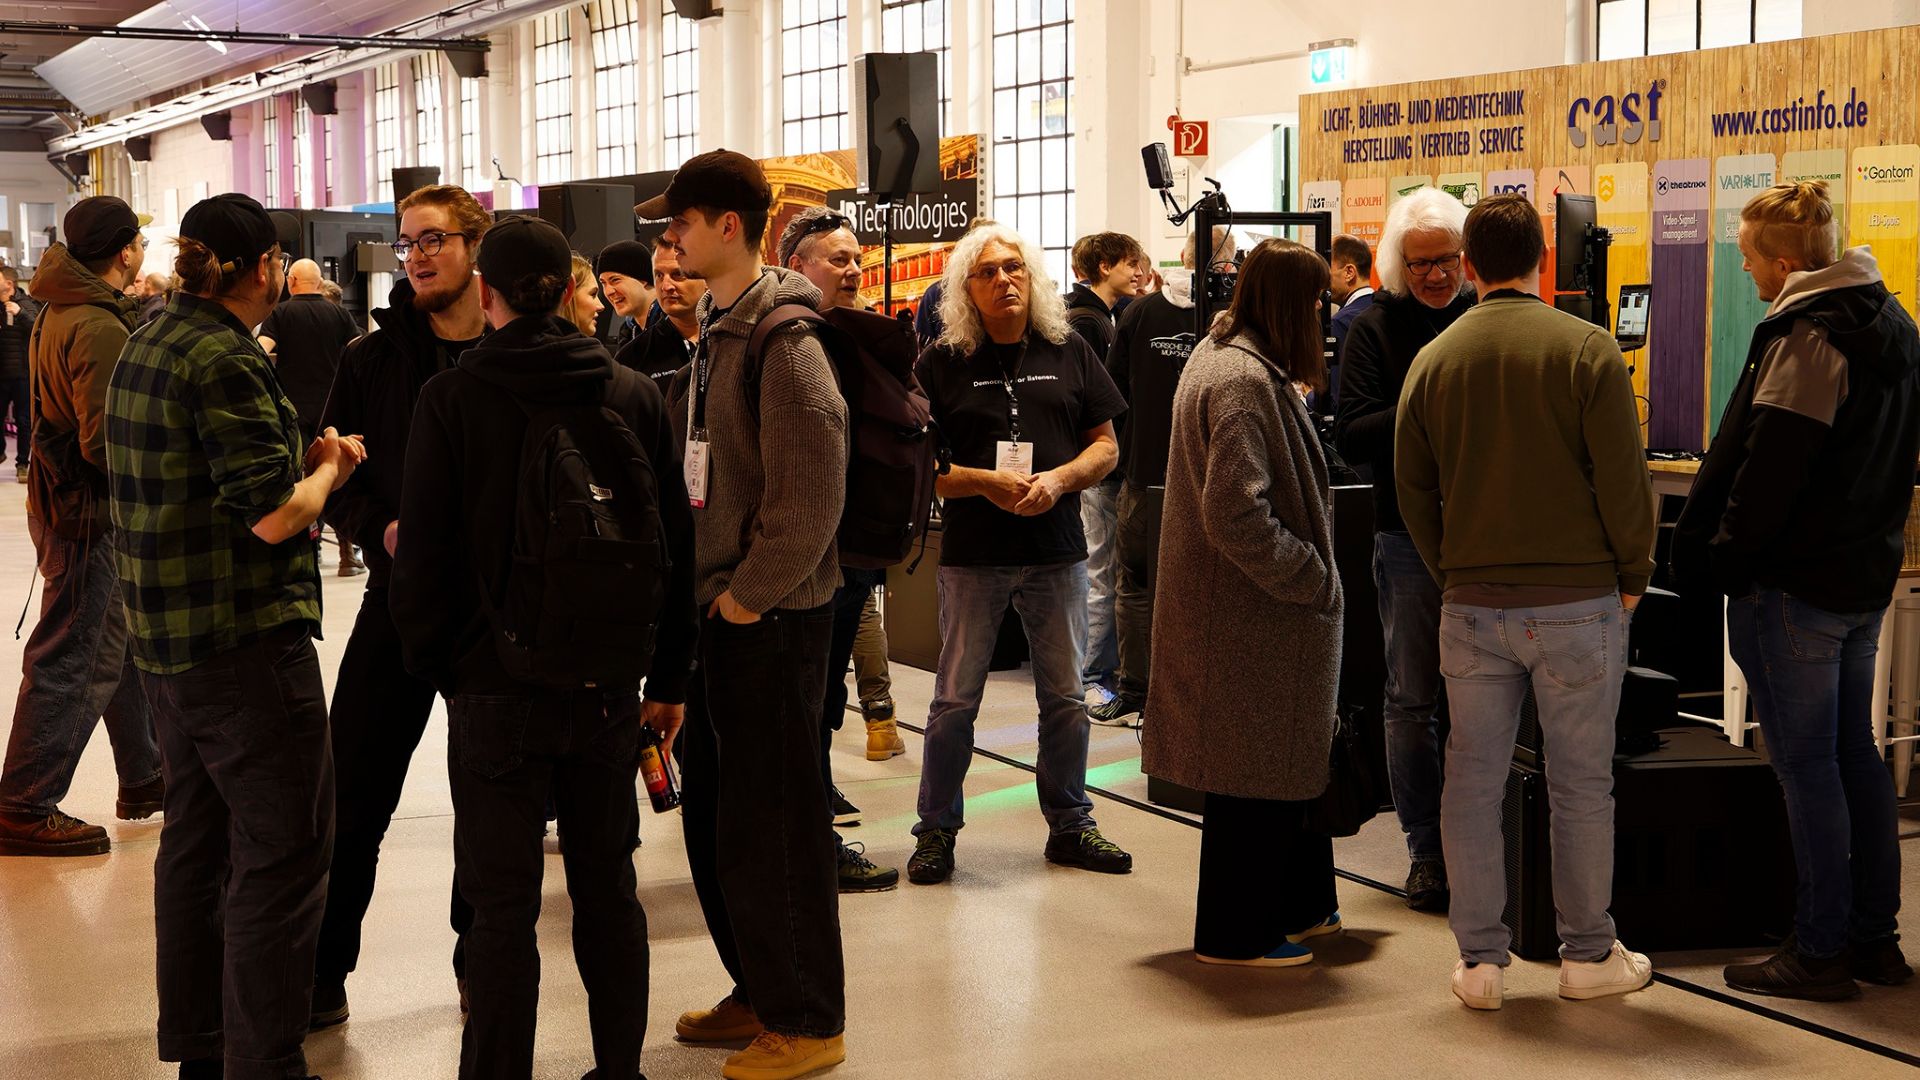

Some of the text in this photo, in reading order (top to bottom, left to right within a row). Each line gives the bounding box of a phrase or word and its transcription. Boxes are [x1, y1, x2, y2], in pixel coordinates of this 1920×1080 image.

[1323, 90, 1525, 134] LICHT-, BÜHNEN- UND MEDIENTECHNIK
[1712, 87, 1868, 137] www.castinfo.de
[1343, 126, 1524, 163] HERSTELLUNG VERTRIEB SERVICE
[1670, 181, 1706, 190] theatrixx
[1868, 165, 1913, 180] Gantom
[1026, 375, 1059, 383] listeners.
